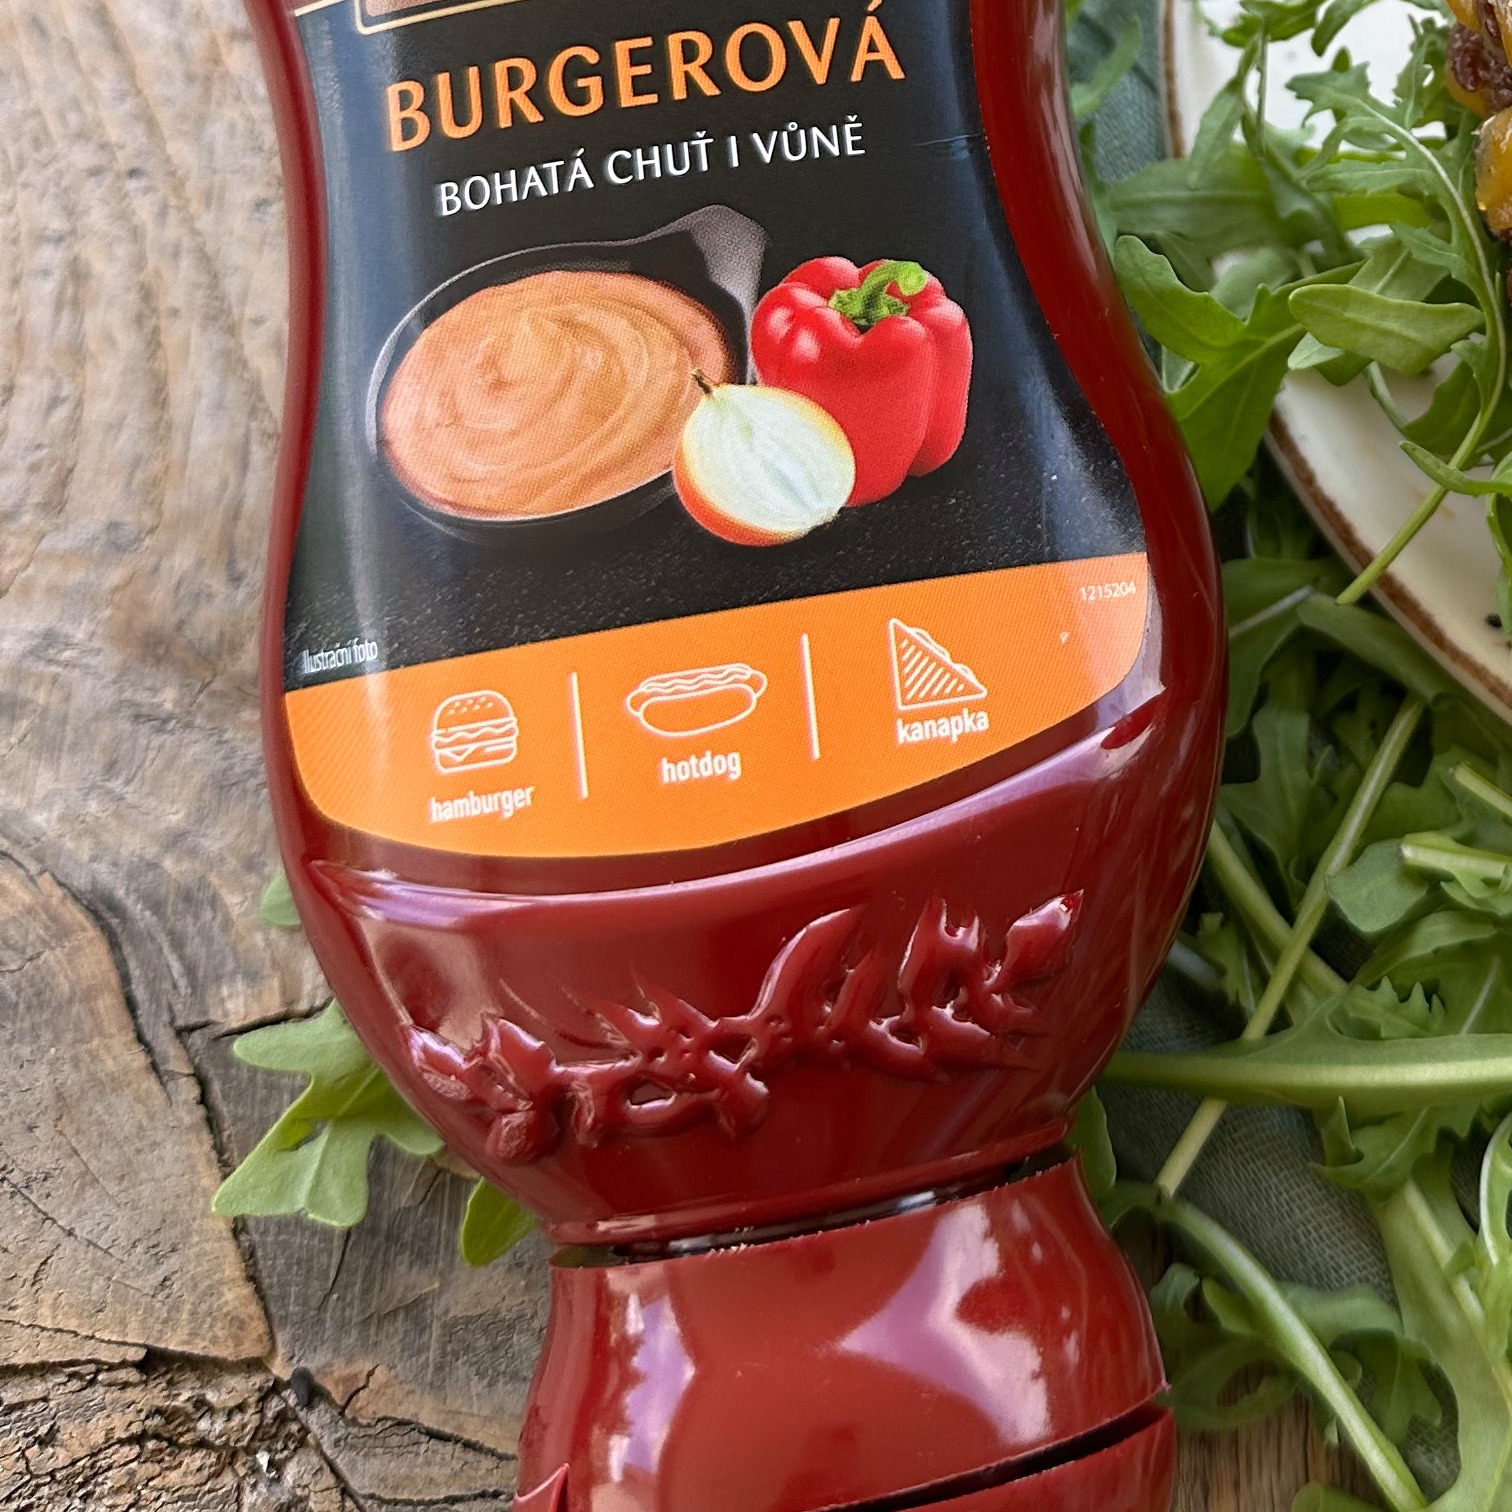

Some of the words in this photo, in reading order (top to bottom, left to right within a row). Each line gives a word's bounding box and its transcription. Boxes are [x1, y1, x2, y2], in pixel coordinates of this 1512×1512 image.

[438, 148, 594, 216] BOHATÁ
[606, 136, 711, 185] CHUŤ
[730, 135, 740, 168] I
[753, 114, 867, 163] VŮNĚ
[1080, 581, 1137, 602] 1215204
[350, 637, 379, 664] foto
[896, 707, 990, 744] kanapka
[661, 749, 743, 784] hotdog
[430, 785, 537, 823] hamburger
